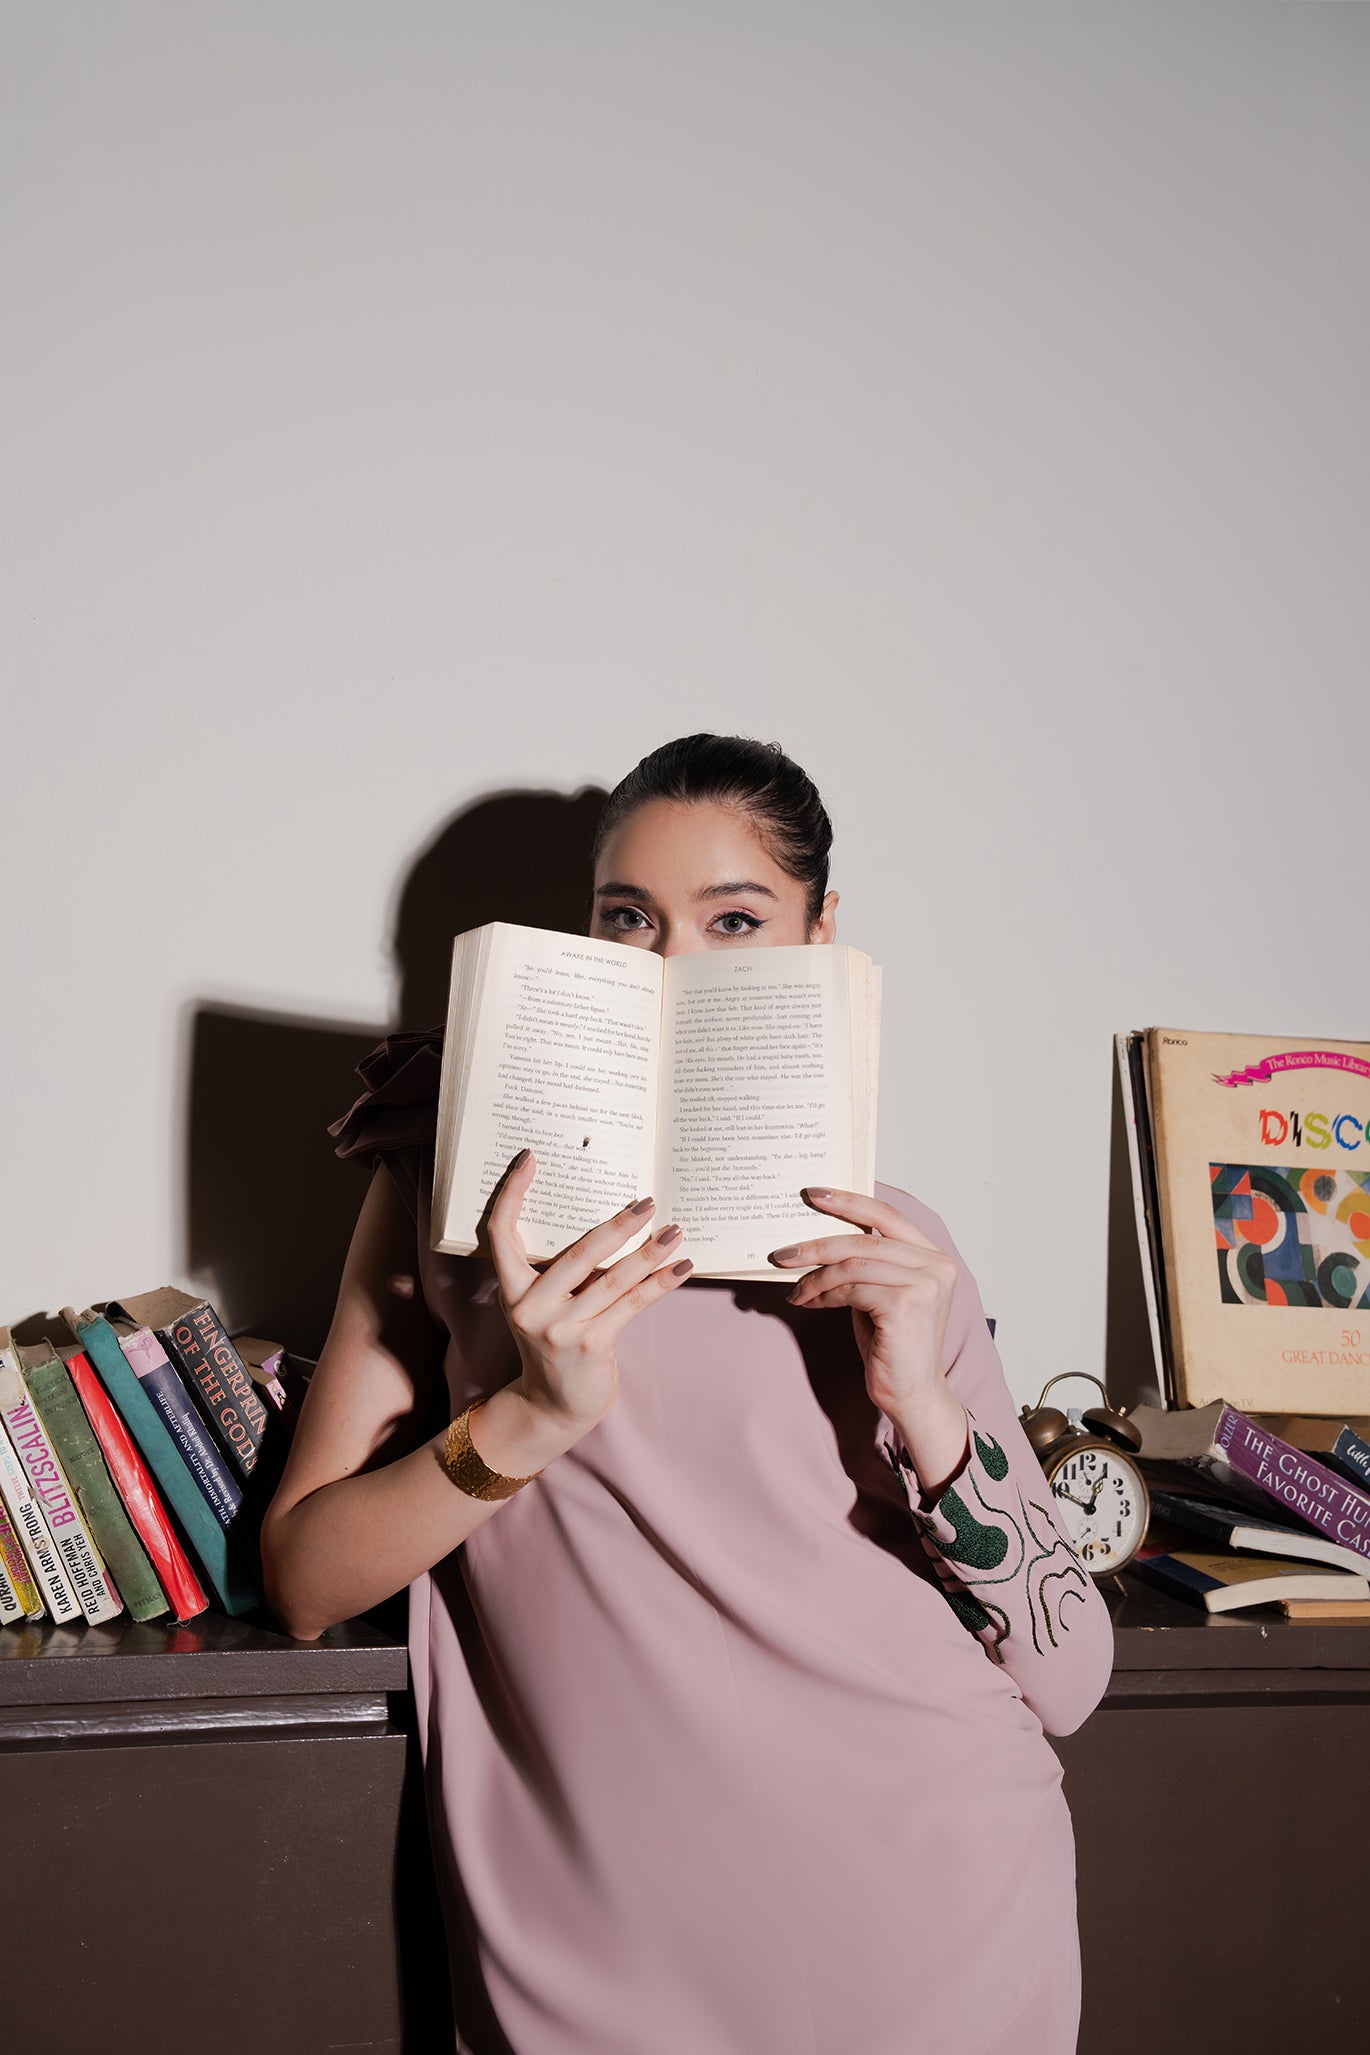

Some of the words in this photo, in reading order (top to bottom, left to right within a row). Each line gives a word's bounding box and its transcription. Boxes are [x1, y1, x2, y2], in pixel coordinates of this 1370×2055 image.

[561, 951, 584, 960] AWAKE
[606, 959, 627, 968] WORLD
[1163, 1037, 1188, 1046] Ronco
[1266, 1058, 1284, 1070] The
[1285, 1054, 1313, 1066] Ronco
[1314, 1054, 1340, 1066] Music
[1258, 1109, 1370, 1150] DISC
[523, 1136, 545, 1145] thought
[616, 1181, 637, 1190] thinking
[1341, 1330, 1361, 1348] 50
[1282, 1350, 1325, 1364] GREAT
[194, 1310, 268, 1435] FINGERPRIN
[176, 1326, 200, 1354] OF
[194, 1358, 226, 1406] THE
[220, 1408, 258, 1470] GODS
[156, 1391, 182, 1433] AFTERLIFE
[182, 1412, 197, 1436] Khaliq
[1220, 1414, 1238, 1449] OLZER
[180, 1434, 192, 1452] AND
[192, 1436, 207, 1457] Abdul
[6, 1395, 76, 1528] BLITZSCALIN
[203, 1456, 214, 1469] Dr.
[1080, 1454, 1096, 1471] 12
[1102, 1462, 1108, 1478] 1
[1243, 1426, 1273, 1461] THE
[1278, 1454, 1338, 1503] GHOST
[190, 1452, 221, 1506] IMMORTALITY
[211, 1466, 220, 1478] by
[1063, 1464, 1076, 1480] 11
[214, 1477, 232, 1503] Revised
[1113, 1478, 1124, 1495] 2
[218, 1505, 232, 1525] ATH,
[228, 1502, 236, 1511] &
[1120, 1500, 1130, 1517] 3
[1257, 1461, 1333, 1527] FAVORITE
[1337, 1519, 1370, 1556] CAS
[19, 1502, 56, 1573] ARMSTRONG
[73, 1534, 86, 1551] YEH
[1100, 1538, 1111, 1554] 5
[1082, 1543, 1094, 1561] 6
[60, 1538, 89, 1588] HOFFMAN
[81, 1552, 98, 1577] CHRIS
[48, 1574, 72, 1614] KAREN
[92, 1580, 106, 1596] AND
[82, 1590, 100, 1615] REID
